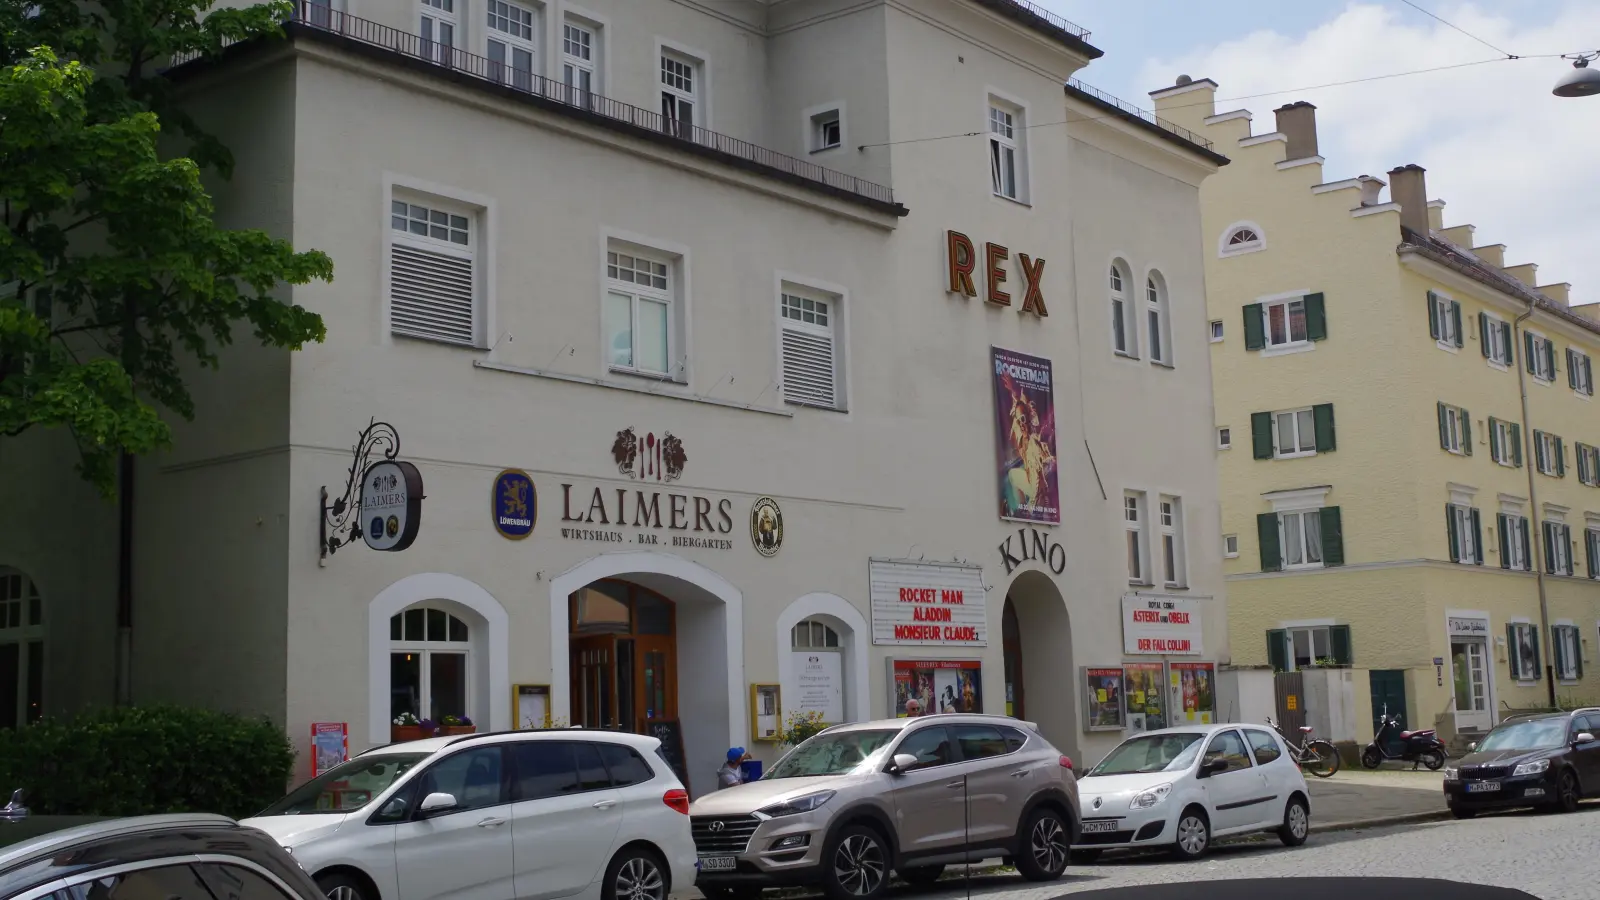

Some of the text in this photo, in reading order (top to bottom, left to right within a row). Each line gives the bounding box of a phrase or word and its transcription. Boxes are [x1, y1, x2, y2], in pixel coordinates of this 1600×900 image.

[946, 230, 1048, 317] REX
[995, 359, 1050, 386] ROCKETMAN
[365, 492, 405, 507] LAIMERS
[561, 483, 733, 534] LAIMERS
[500, 516, 531, 527] LÖWENBRÄU
[561, 527, 733, 550] WIRTSHAUS BAR BIERGARTEN
[999, 528, 1066, 576] KINO
[900, 587, 964, 604] ROCKET MAN
[913, 606, 952, 622] ALADDIN
[1133, 610, 1160, 623] ASTERIX
[1168, 611, 1190, 624] OBELIX
[894, 625, 942, 641] MONSIEUR
[943, 626, 976, 641] CLAUDE
[1138, 639, 1191, 652] DER FALL COLLINI
[708, 858, 717, 869] SD
[718, 857, 735, 868] 3300
